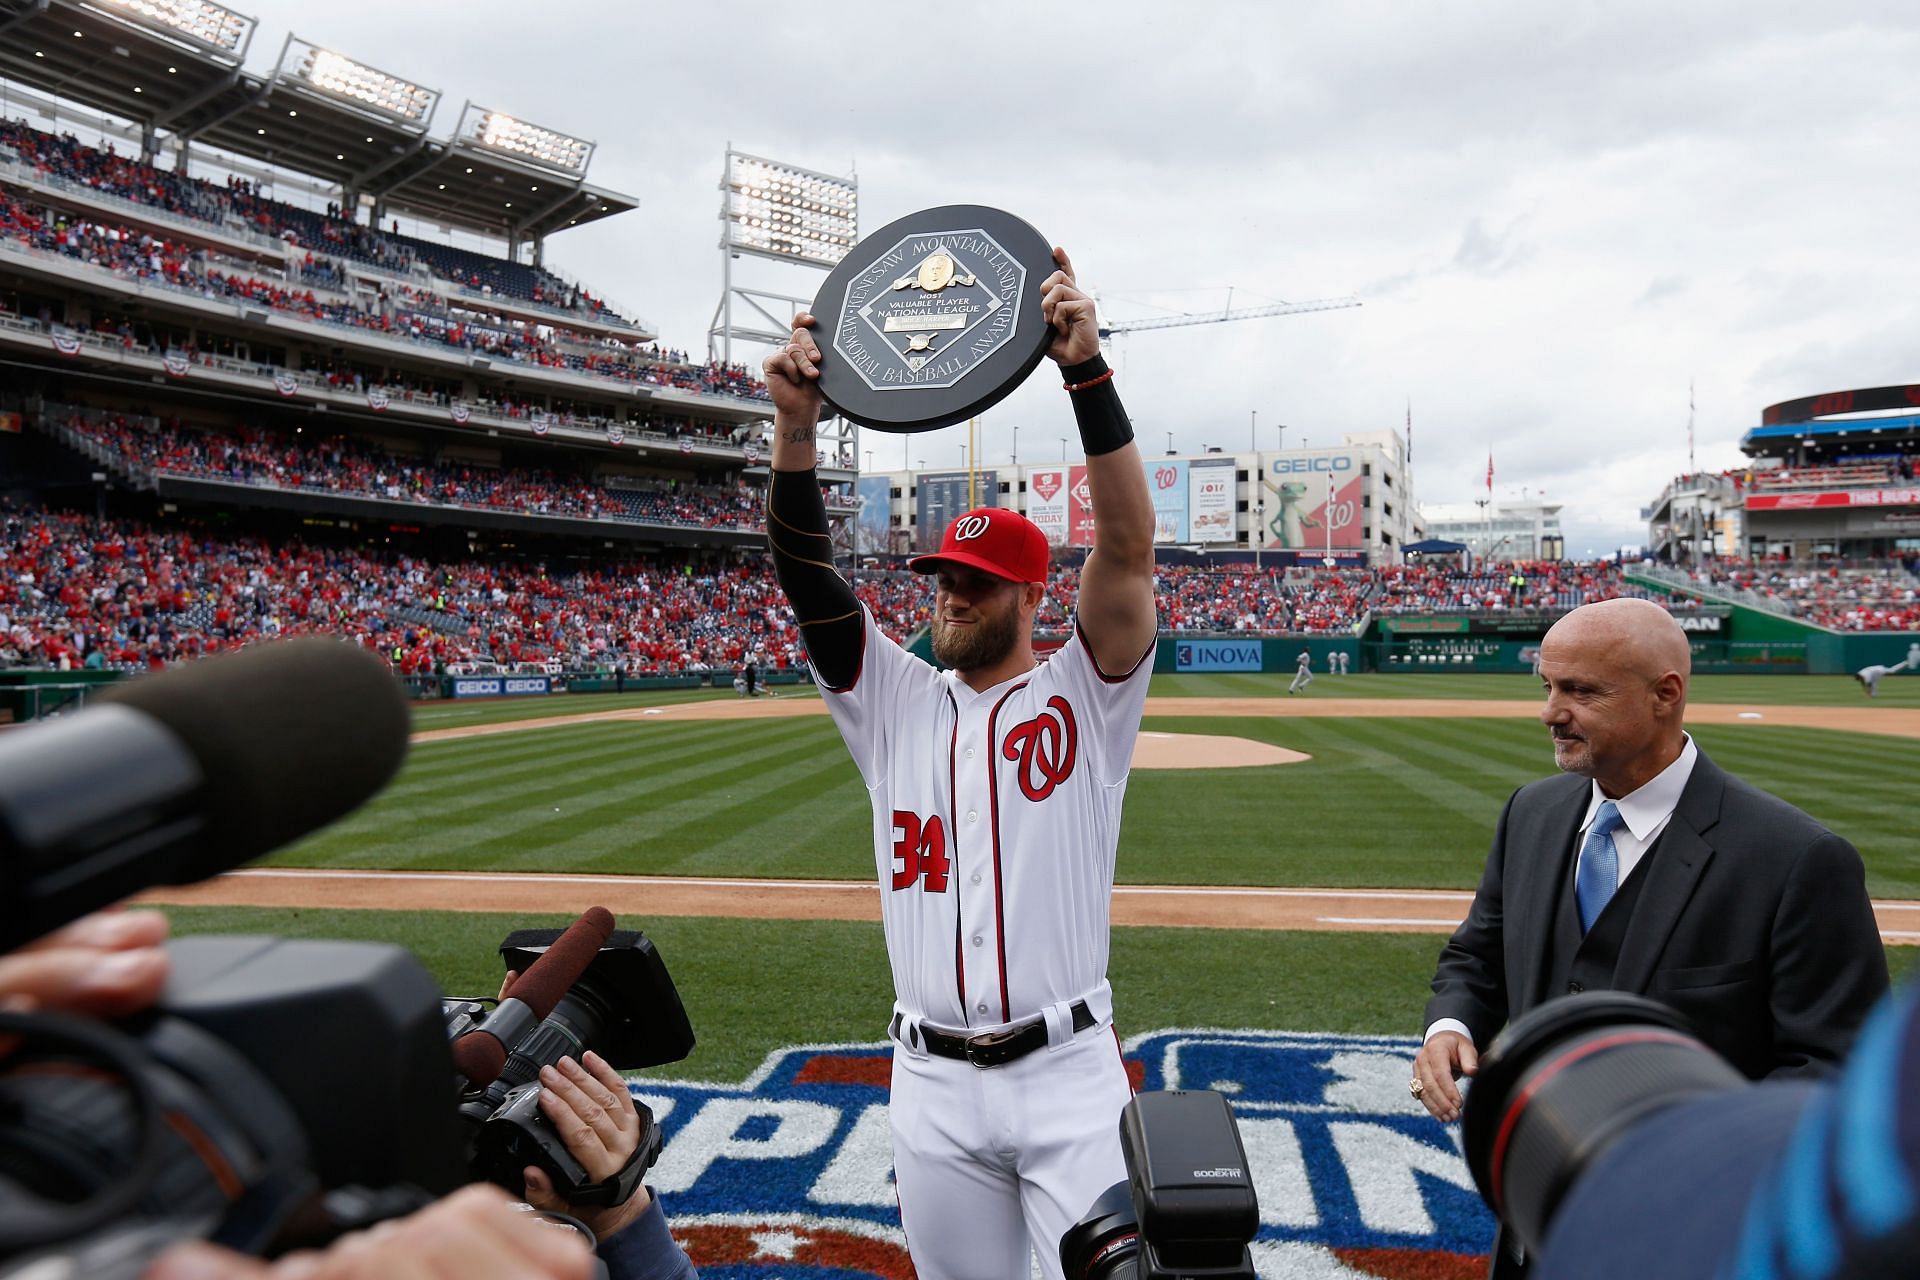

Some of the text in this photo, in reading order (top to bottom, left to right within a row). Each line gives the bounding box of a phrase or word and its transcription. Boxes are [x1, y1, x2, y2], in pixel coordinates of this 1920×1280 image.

[848, 236, 1018, 308] KENESAW MOUNTAIN LANDIS
[889, 298, 970, 309] VALUABLE PLAYER
[919, 292, 944, 300] MOST
[877, 305, 980, 318] NATIONAL LEAGUE
[842, 308, 1013, 383] MEMORIAL BASEBALL AWARD
[1273, 456, 1351, 474] GEICO
[1032, 514, 1064, 523] TODAY
[955, 515, 990, 541] W
[1199, 647, 1260, 664] INOVA
[456, 681, 500, 694] GEICO
[505, 679, 546, 692] GEICO
[1003, 695, 1077, 802] W
[892, 809, 951, 894] 34
